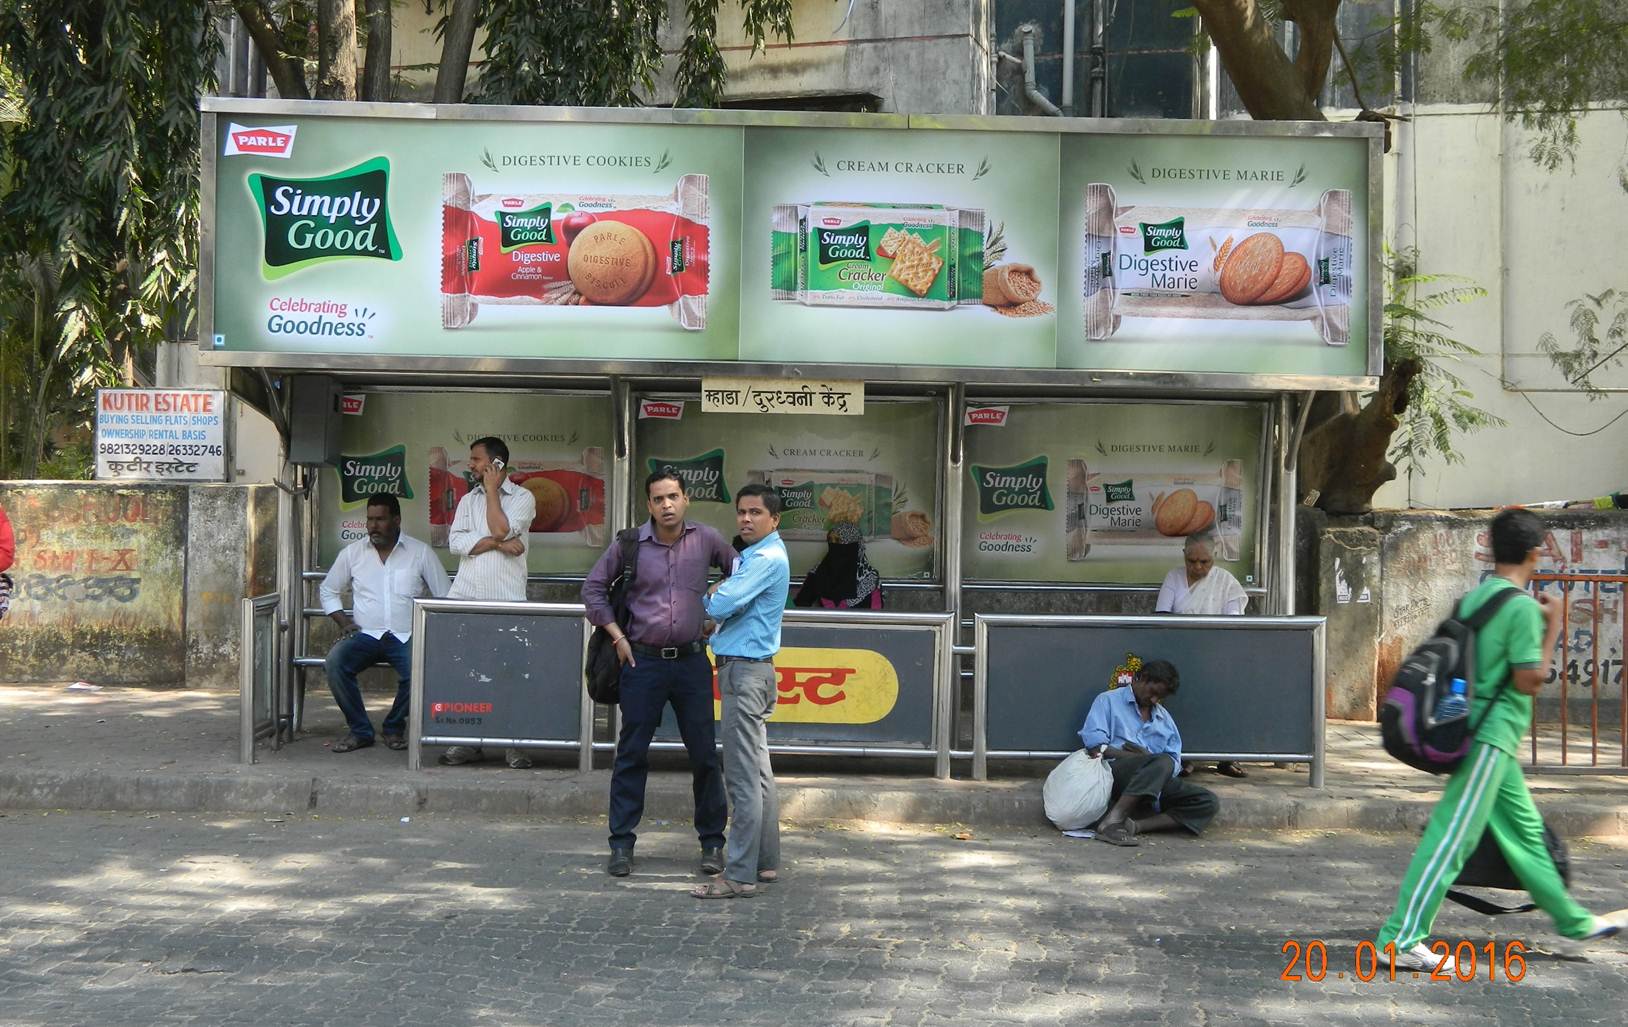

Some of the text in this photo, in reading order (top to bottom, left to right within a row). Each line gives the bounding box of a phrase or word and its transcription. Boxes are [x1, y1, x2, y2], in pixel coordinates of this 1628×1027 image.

[238, 135, 286, 147] PARLE
[502, 155, 651, 167] DIGESTIVE COOKIES
[836, 160, 965, 175] CREAM CRACKER
[1151, 167, 1284, 182] DIGESTIVE MARIE
[270, 185, 381, 226] Simply
[503, 214, 548, 231] Simply
[287, 219, 378, 251] Good
[510, 228, 548, 241] Good
[821, 231, 867, 248] Simply
[1146, 226, 1182, 239] Simply
[1151, 236, 1180, 247] Good
[512, 250, 560, 264] Digestive
[828, 245, 865, 258] Good
[583, 254, 632, 267] DIGESTIVE
[1119, 253, 1199, 276] Digestive
[517, 265, 536, 274] Apple
[838, 267, 886, 282] Cracker
[1151, 273, 1198, 290] Marie
[269, 297, 348, 318] Celebrating
[267, 314, 366, 337] Goodness
[102, 392, 213, 413] KUTIR ESTATE
[818, 384, 851, 413] केंद्र
[646, 405, 678, 414] PARLE
[99, 414, 129, 424] BUYING
[130, 415, 164, 425] SELLING
[181, 430, 207, 441] BASIS
[783, 448, 864, 457] CREAM CRACKER
[1111, 444, 1201, 453] DIGESTIVE MARIE
[106, 456, 199, 477] कुटीर इस्टेट
[343, 460, 402, 481] Simply
[353, 477, 401, 495] Good
[983, 471, 1043, 492] Simply
[685, 484, 718, 499] ood
[780, 489, 812, 500] Simply
[992, 489, 1041, 506] Good
[784, 498, 811, 508] Good
[1089, 503, 1142, 519] Digestive
[1110, 516, 1142, 527] Marie
[979, 531, 1022, 543] Celebrating
[978, 541, 1032, 553] Goodness
[441, 702, 493, 713] PIONEER
